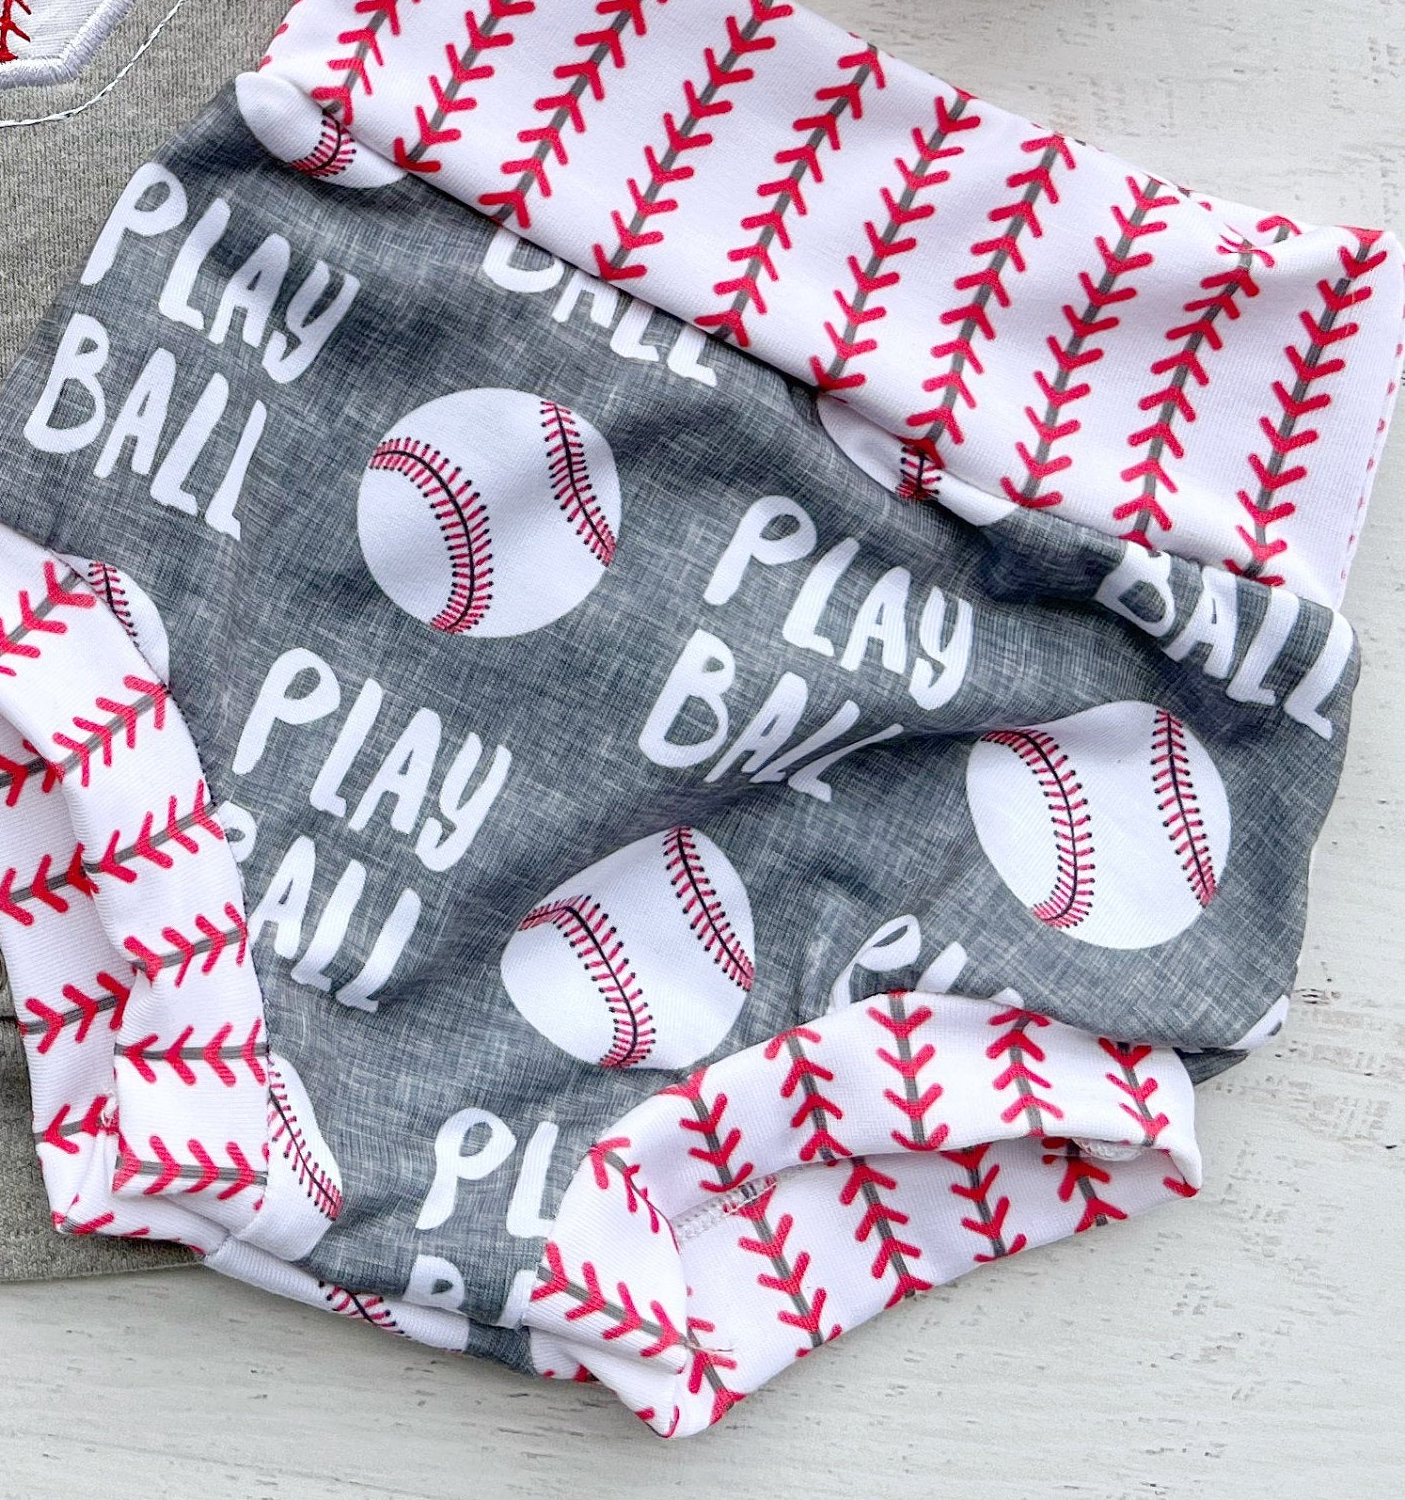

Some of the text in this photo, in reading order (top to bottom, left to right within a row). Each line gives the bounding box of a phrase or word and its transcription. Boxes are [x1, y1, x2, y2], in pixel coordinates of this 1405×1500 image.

[80, 162, 360, 384] PLAY
[23, 313, 267, 541] BALL
[704, 496, 973, 710] PLAY
[1094, 540, 1353, 742] BALL
[232, 647, 512, 871] PLAY
[638, 629, 904, 803] BALL
[415, 1107, 559, 1238] PL
